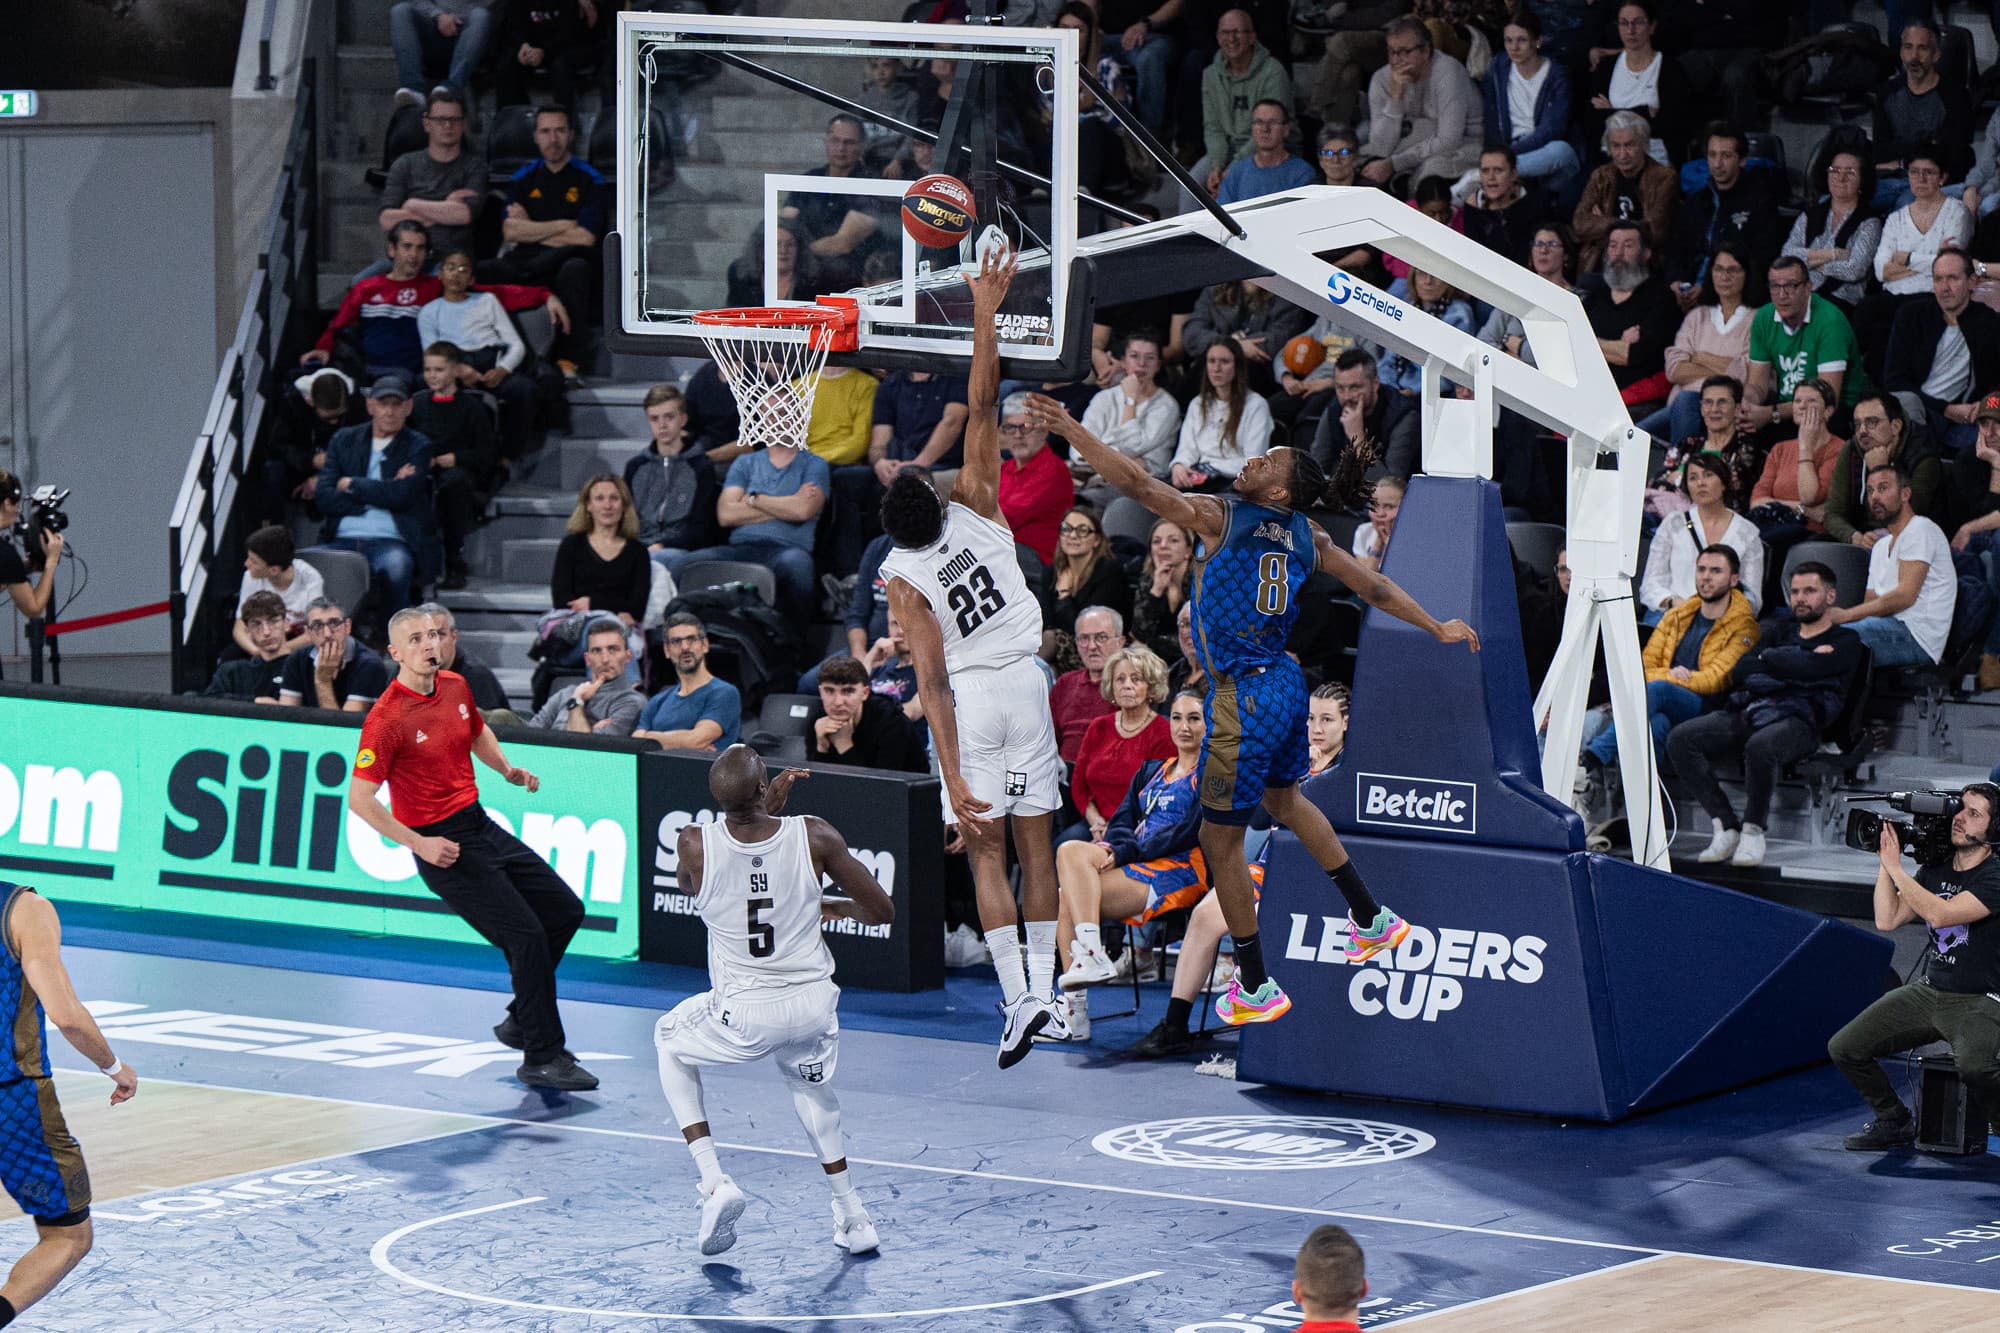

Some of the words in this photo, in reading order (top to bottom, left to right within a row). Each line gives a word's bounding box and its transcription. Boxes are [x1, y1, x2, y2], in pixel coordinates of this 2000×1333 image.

[917, 197, 967, 228] SPALDING
[994, 313, 1049, 330] EADERS
[1352, 285, 1404, 322] Schelde
[1000, 325, 1030, 340] CUP
[936, 547, 979, 589] SIMON
[1255, 552, 1289, 615] 8
[947, 564, 1007, 639] 23
[162, 744, 627, 904] SiliCm
[1365, 785, 1467, 823] Betclic
[750, 873, 768, 893] SY
[746, 897, 775, 958] 5
[1348, 968, 1464, 1023] CUP
